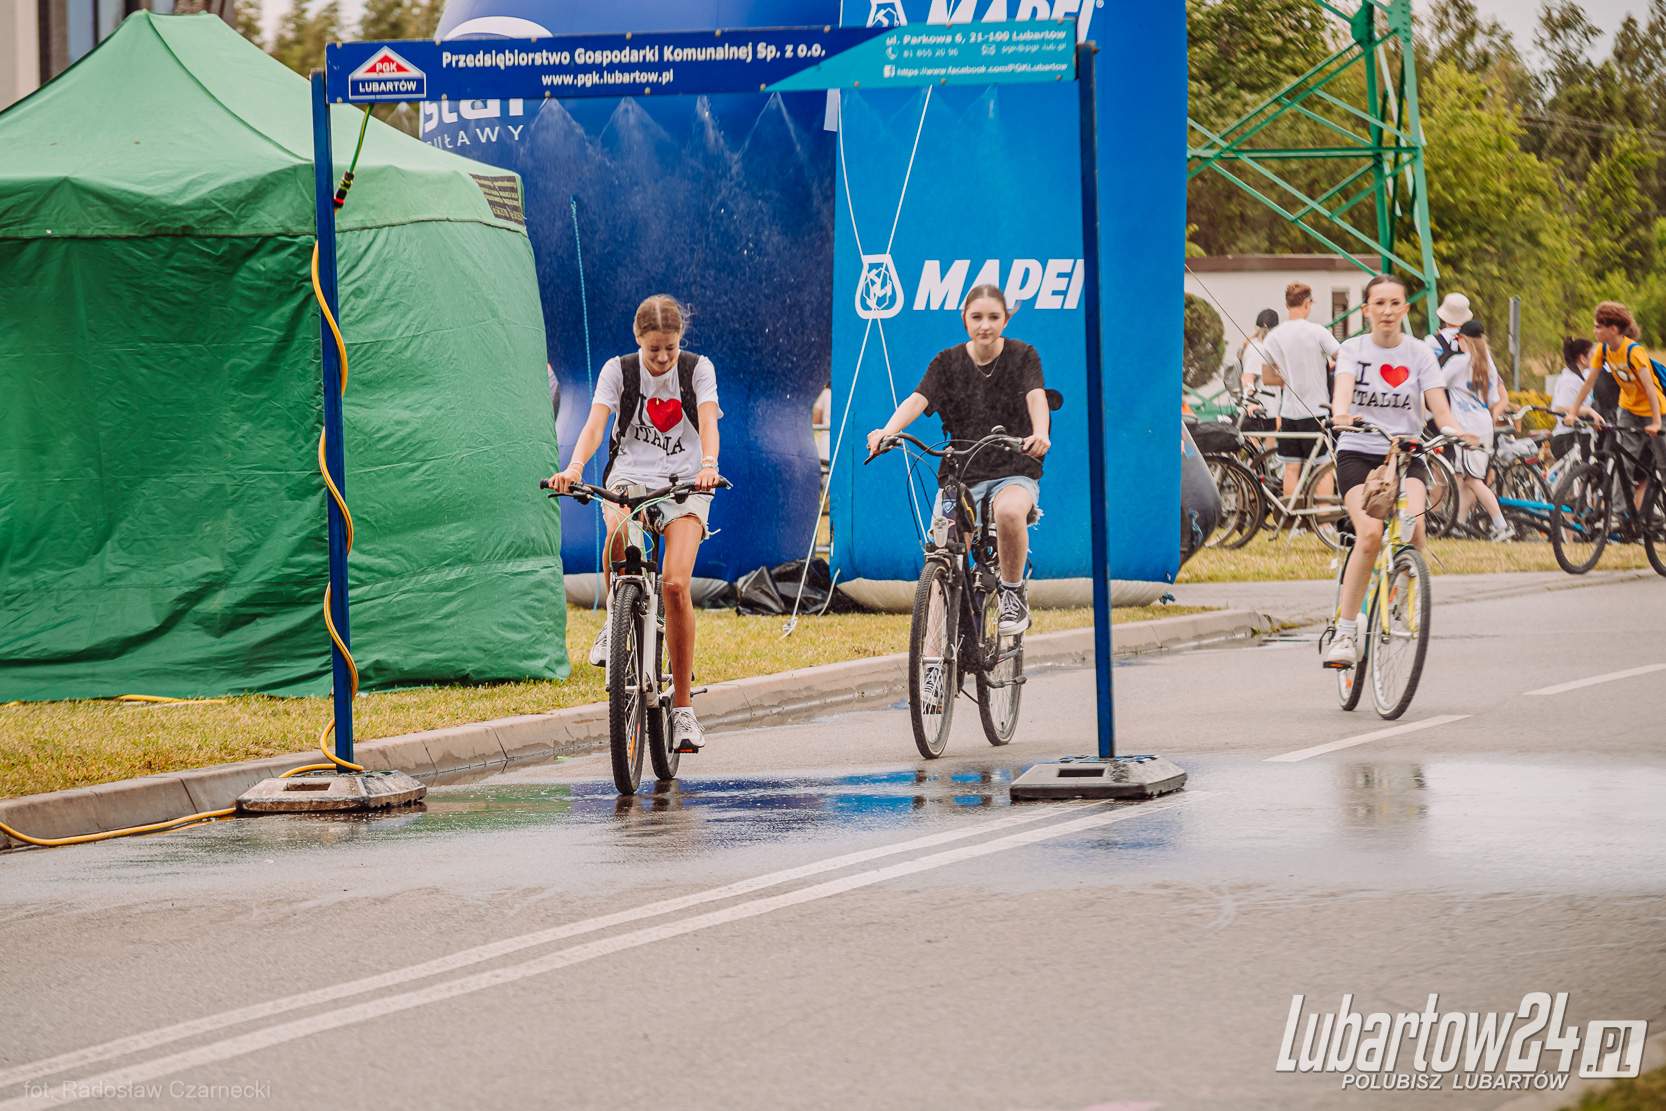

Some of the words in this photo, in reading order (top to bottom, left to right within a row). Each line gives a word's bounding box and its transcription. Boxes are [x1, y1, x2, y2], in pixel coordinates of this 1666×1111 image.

[375, 62, 398, 73] PGK
[442, 49, 570, 69] Przedsiębiorstwo
[575, 45, 658, 66] Gospodarki
[663, 42, 753, 62] Komunalnej
[757, 42, 780, 62] Sp.
[785, 44, 794, 58] z
[797, 43, 825, 57] o.o.
[359, 80, 417, 93] LUBARTÓW
[542, 69, 673, 87] www.pgk.lubartow.pl
[428, 125, 524, 151] UŁAWY
[912, 259, 1085, 310] MAPEI
[1355, 361, 1371, 386] I
[637, 393, 647, 427] I
[1351, 388, 1411, 410] ITALIA
